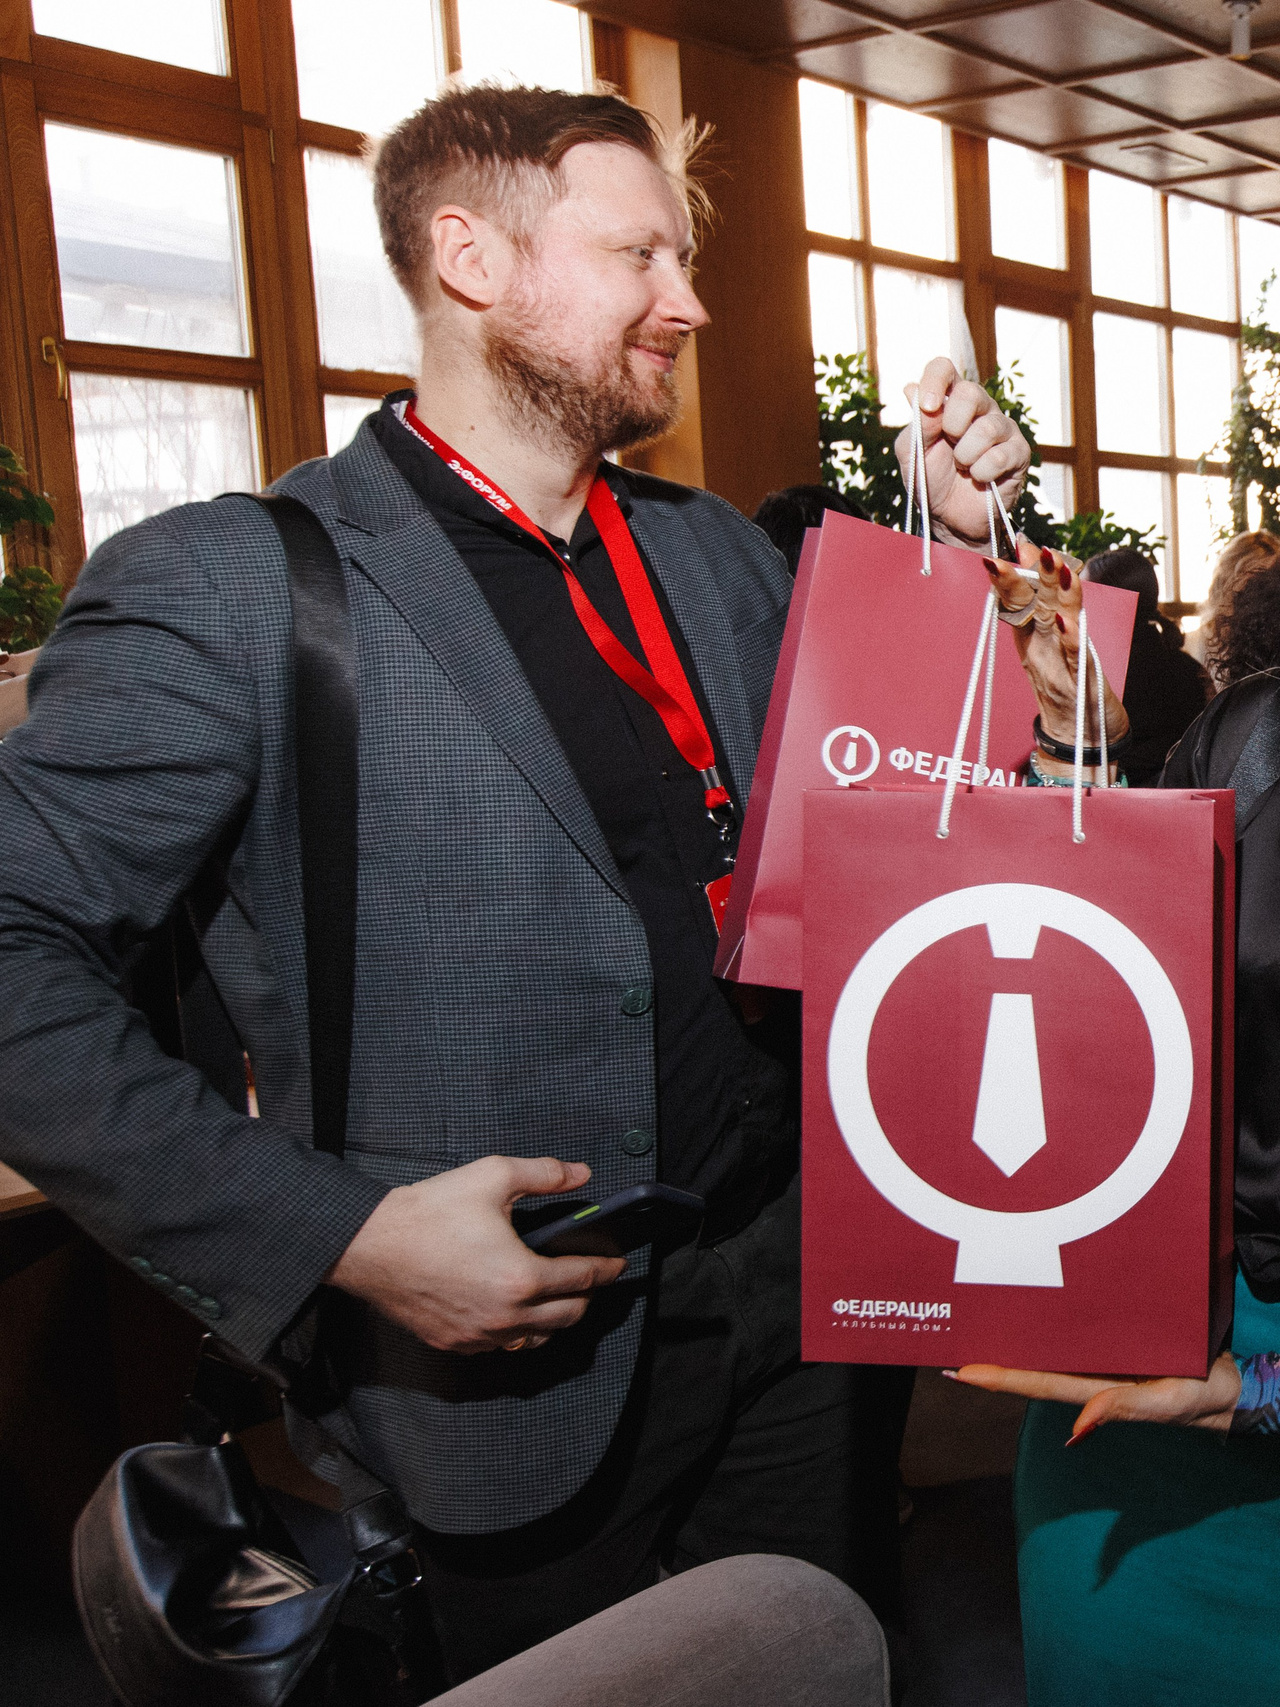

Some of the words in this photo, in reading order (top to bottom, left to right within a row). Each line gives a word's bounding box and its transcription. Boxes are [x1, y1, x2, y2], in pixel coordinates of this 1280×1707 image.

[831, 1298, 952, 1321] ФЕДЕРАЦИЯ
[841, 1319, 907, 1331] КЛУБНЫЙ
[912, 1322, 942, 1332] ДОМ
